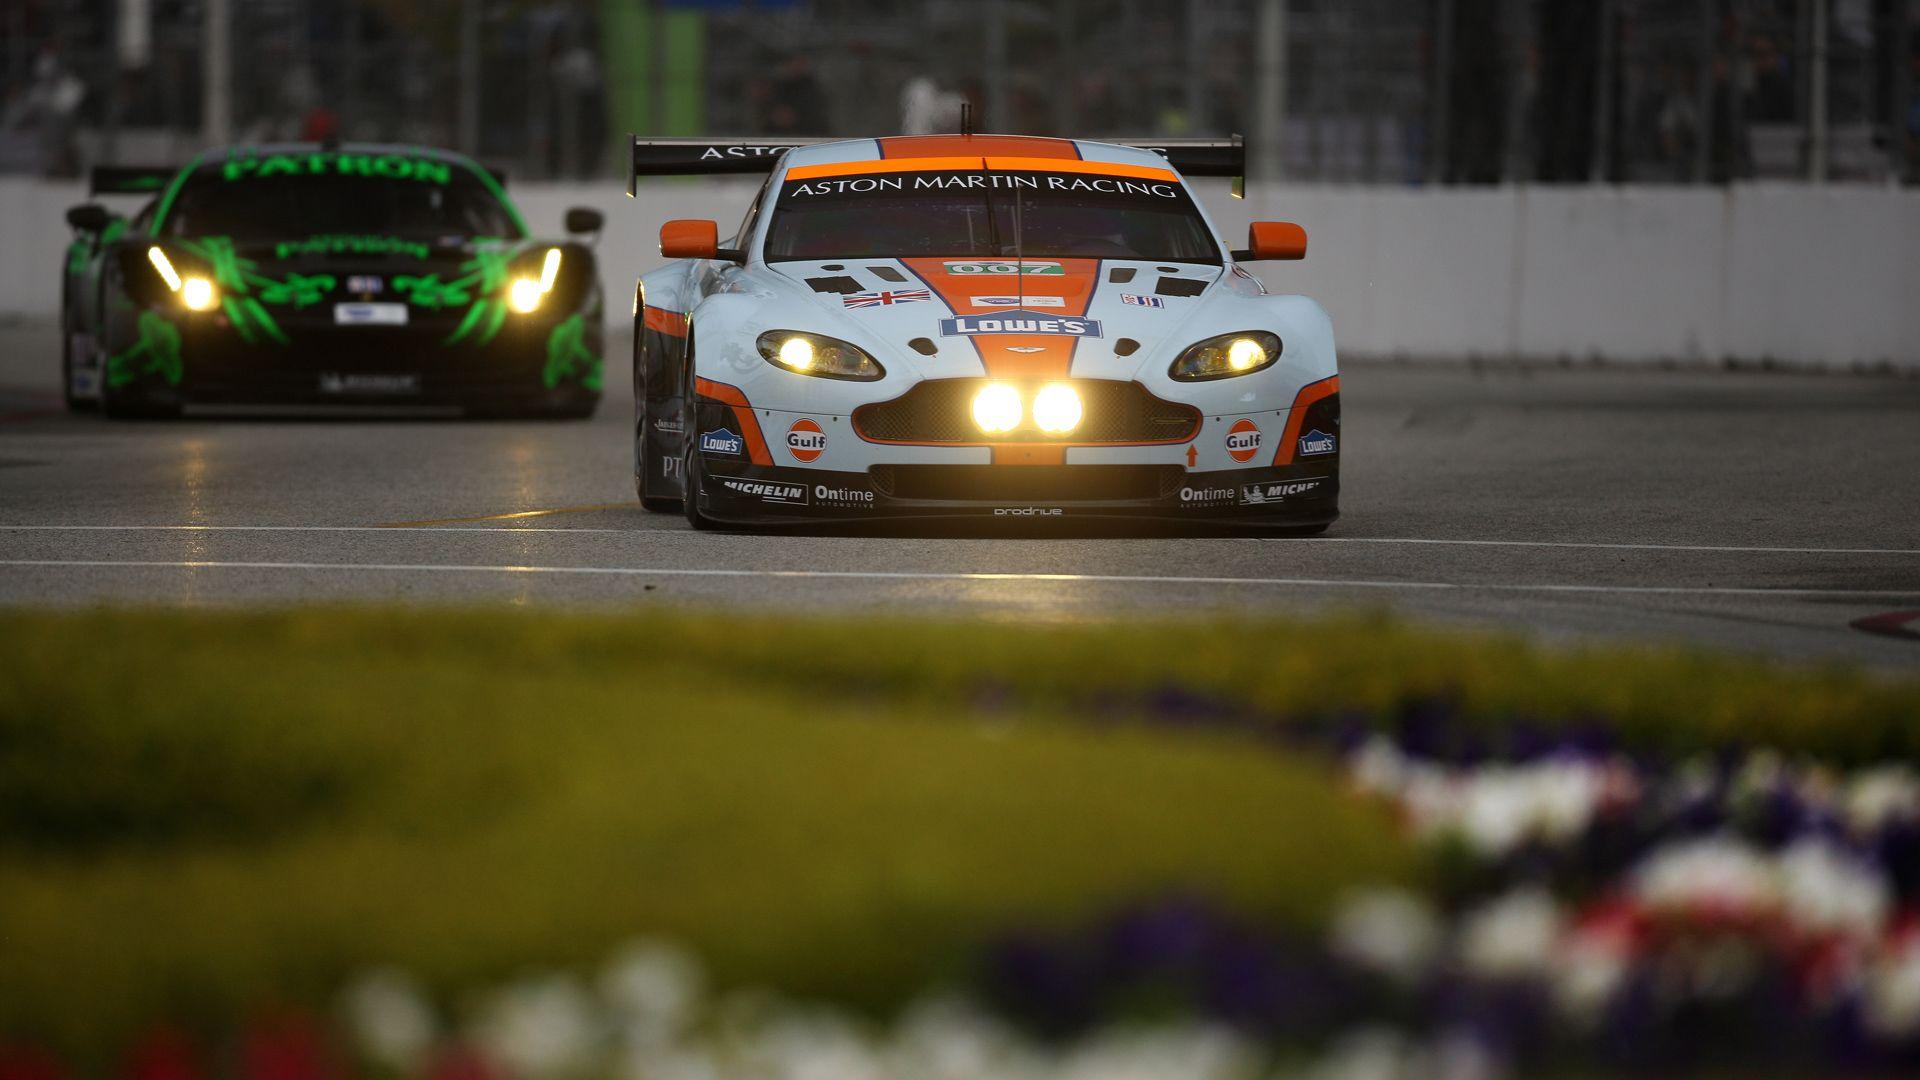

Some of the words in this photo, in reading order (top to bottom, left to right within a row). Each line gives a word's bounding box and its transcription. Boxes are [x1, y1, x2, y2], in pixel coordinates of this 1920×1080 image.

[792, 177, 902, 197] ASTON
[914, 175, 1037, 189] MARTIN
[1048, 177, 1177, 198] RACING
[952, 264, 1051, 273] 007
[956, 318, 1086, 334] LOWE'S
[703, 436, 738, 452] LOWE'S
[787, 432, 825, 449] Gulf
[1226, 434, 1261, 449] Gulf
[1302, 438, 1333, 453] LOWE'S
[724, 481, 802, 498] MICHELIN
[815, 485, 874, 502] Ontime
[1180, 487, 1235, 501] Ontime
[994, 506, 1062, 516] prodrive
